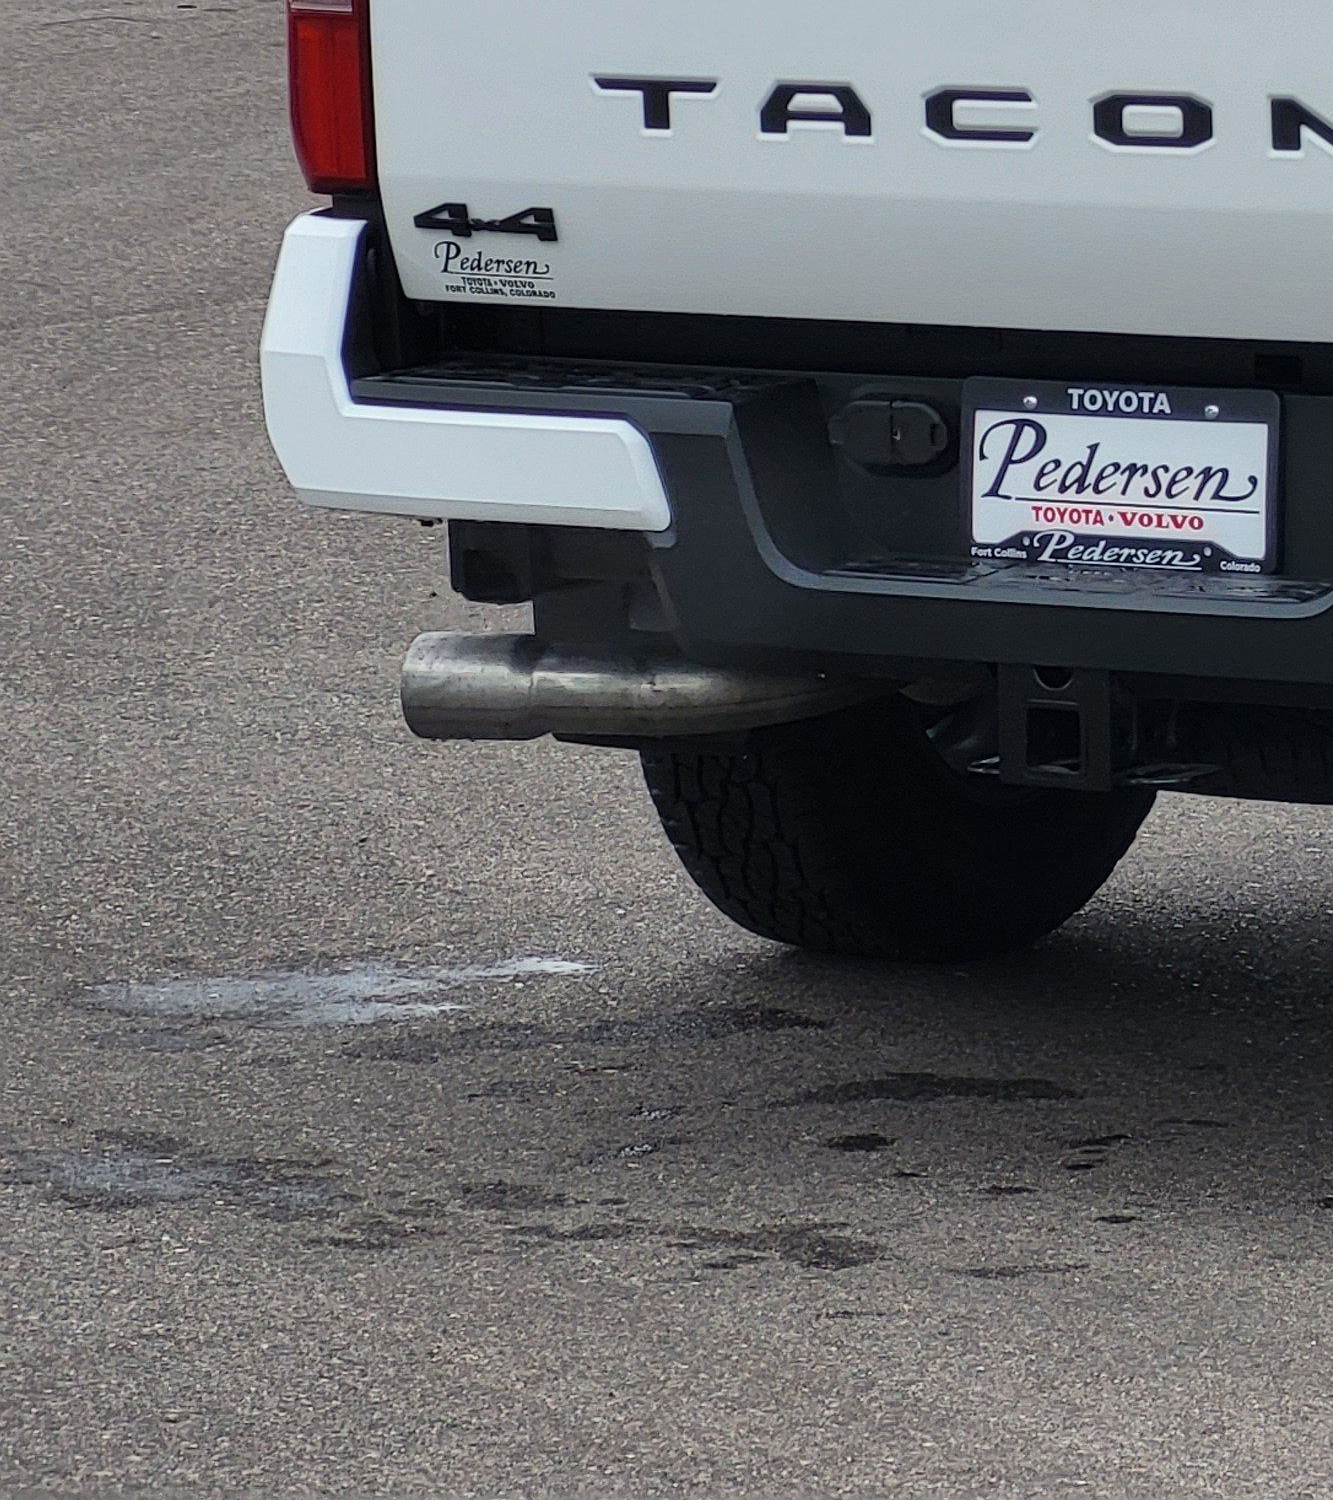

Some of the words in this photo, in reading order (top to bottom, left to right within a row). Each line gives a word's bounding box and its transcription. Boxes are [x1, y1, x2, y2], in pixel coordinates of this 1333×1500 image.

[434, 240, 550, 276] Pedersen
[461, 276, 492, 287] TOYOTA
[499, 278, 535, 290] VOLVO
[509, 288, 556, 299] COLORADO
[1067, 387, 1172, 415] TOYOTA
[979, 418, 1259, 502] Pedersen
[1031, 505, 1105, 527] TOYOTA
[1117, 510, 1204, 531] VOLVO
[970, 546, 993, 558] Fort
[994, 546, 1028, 560] Collins
[1033, 529, 1201, 566] Pedersen
[1219, 560, 1261, 573] Colorado
